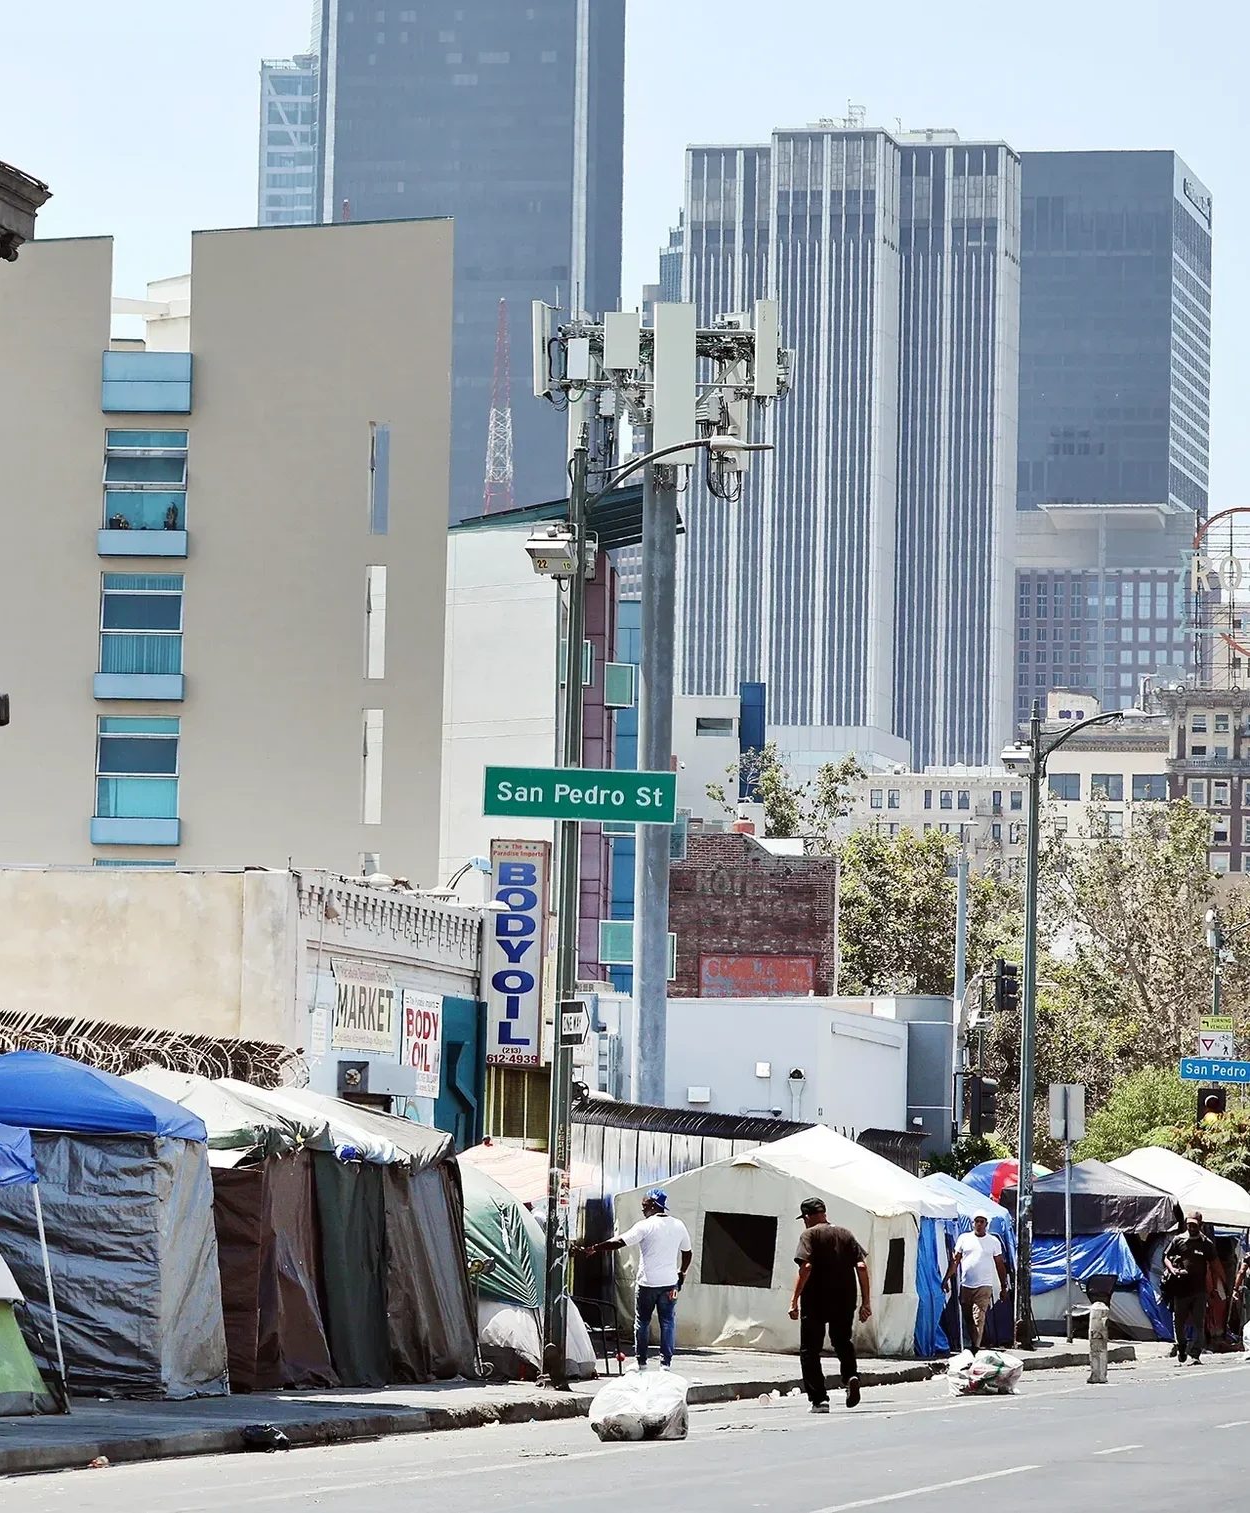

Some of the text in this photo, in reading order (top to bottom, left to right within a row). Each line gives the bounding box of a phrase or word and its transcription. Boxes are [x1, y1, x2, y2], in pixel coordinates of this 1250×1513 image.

[537, 559, 548, 569] 22
[1191, 556, 1250, 592] RO
[497, 781, 663, 807] San Pedro St
[491, 862, 538, 1046] BODY OIL
[336, 982, 394, 1033] MARKET
[405, 1007, 440, 1041] BODY
[411, 1041, 431, 1072] OIL
[502, 1045, 521, 1055] (213)
[1185, 1063, 1247, 1078] San Pedro
